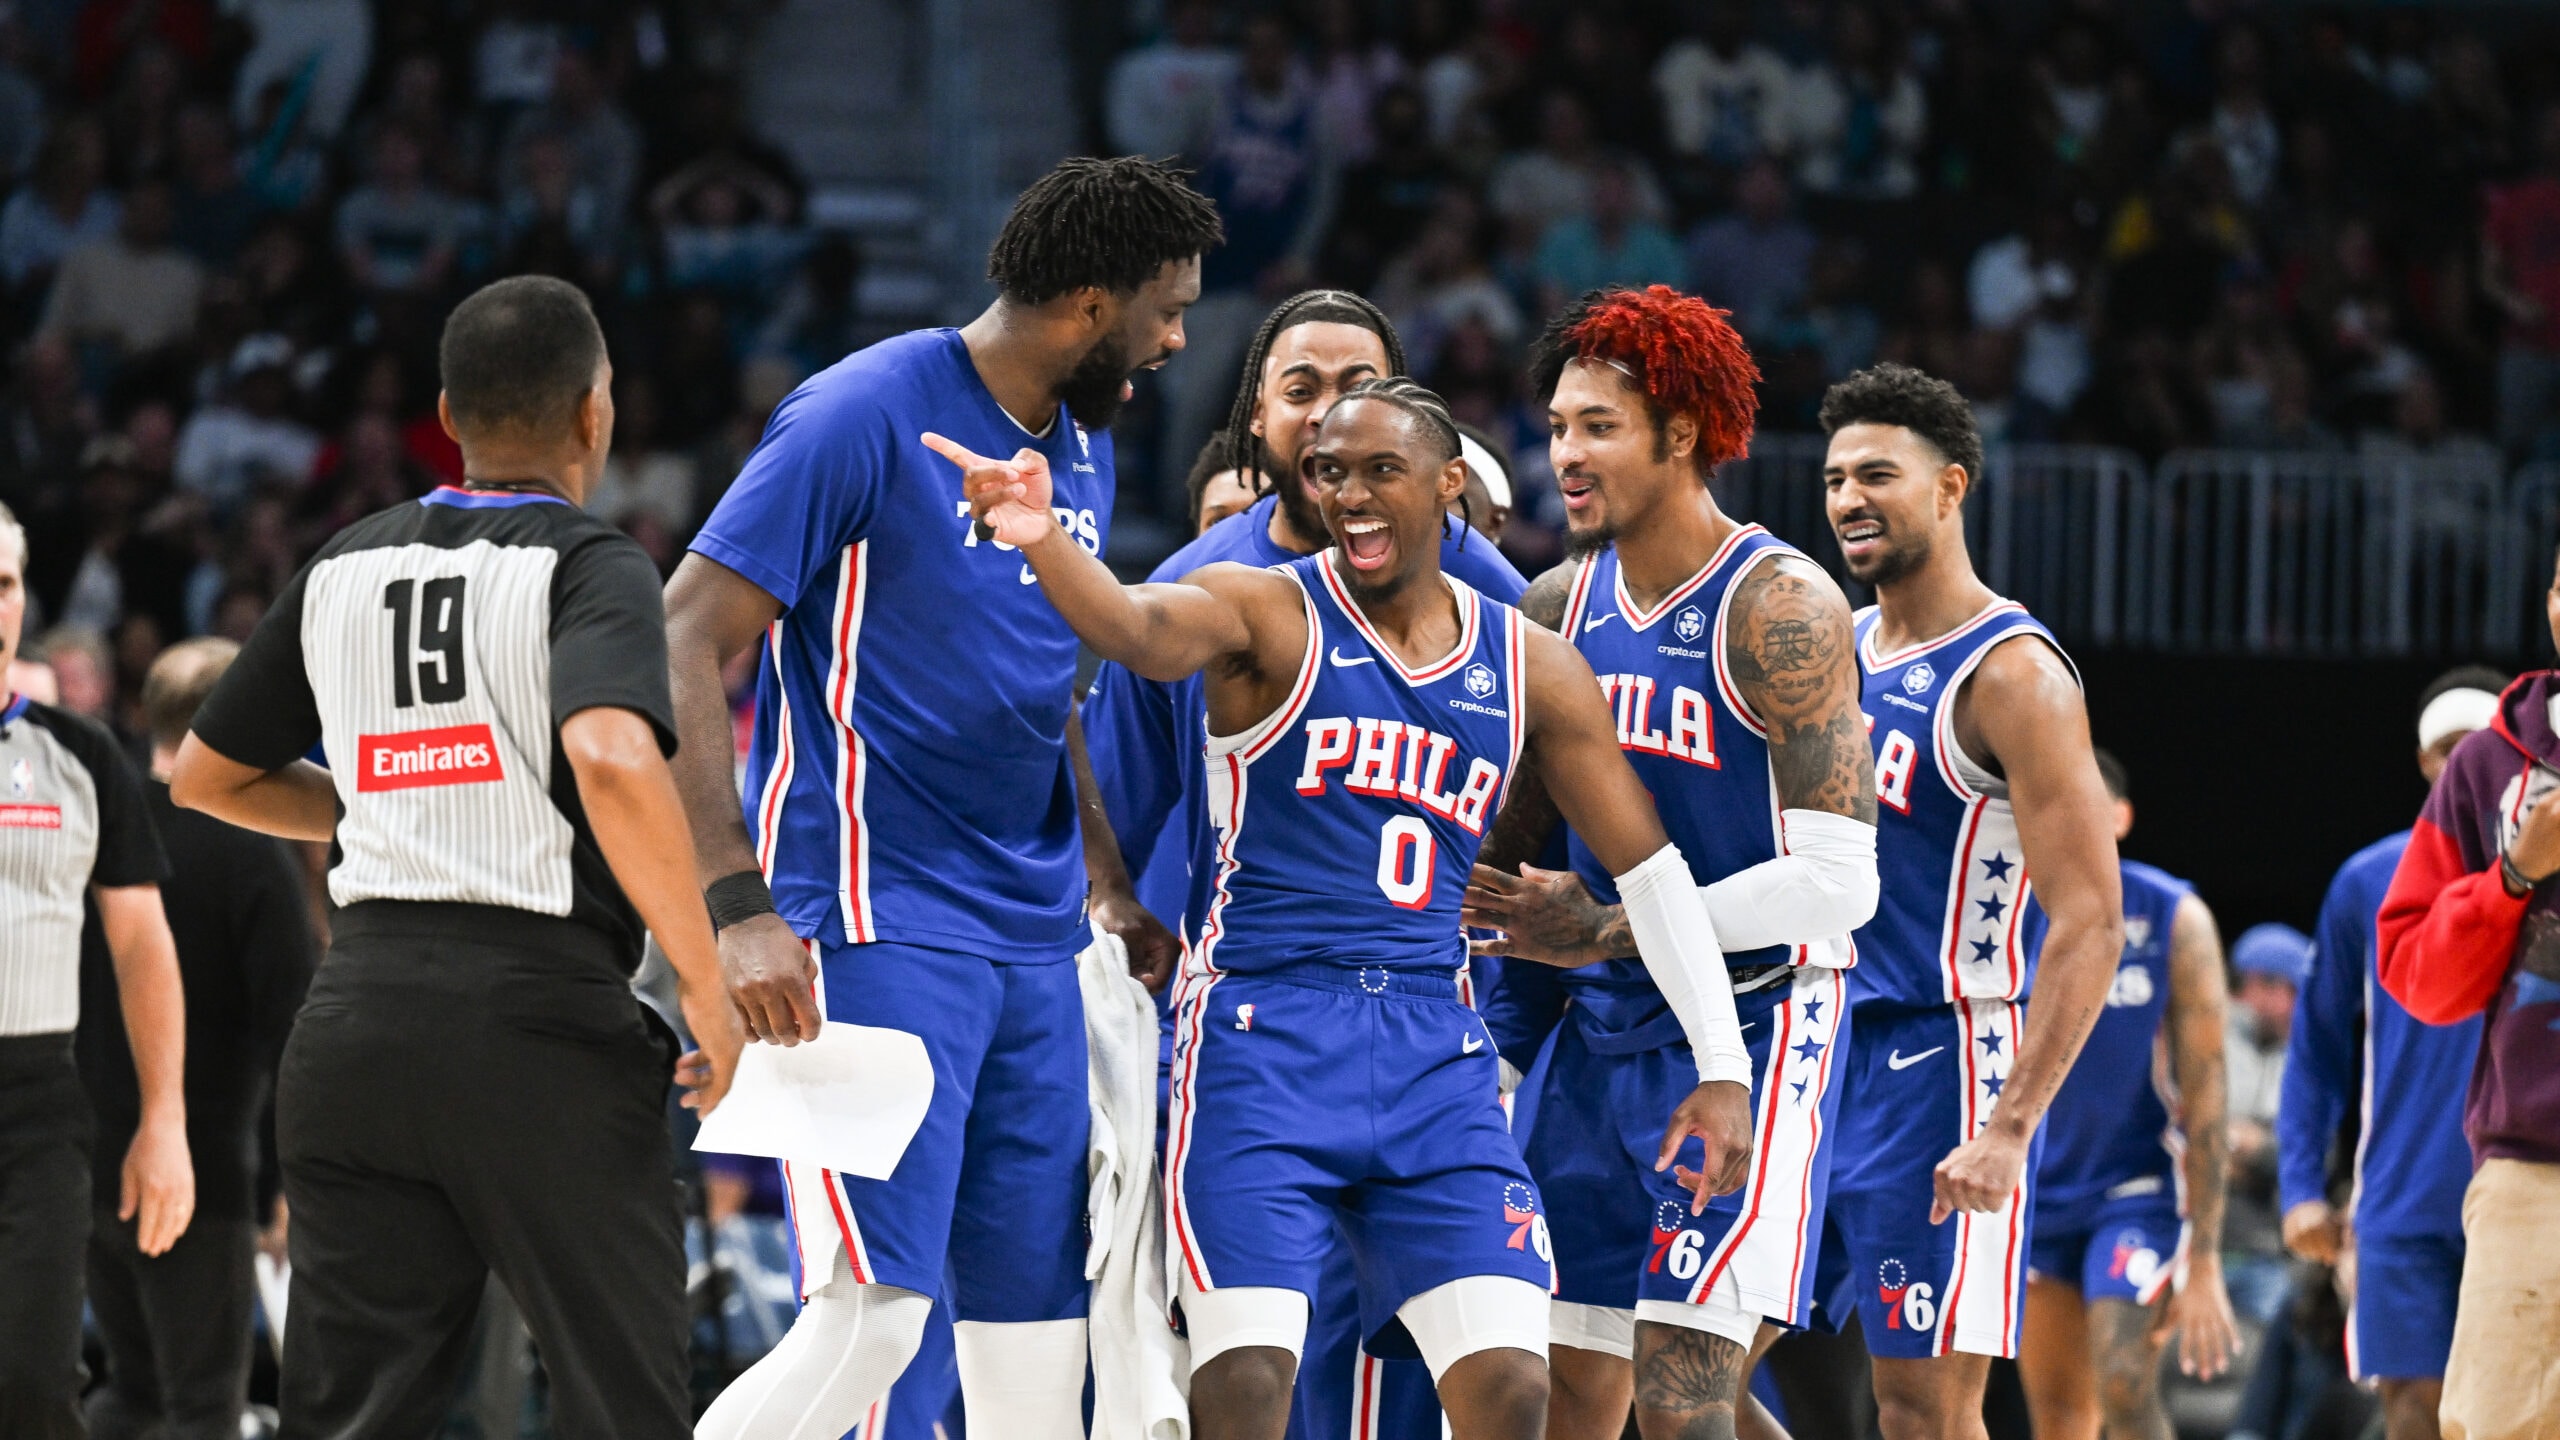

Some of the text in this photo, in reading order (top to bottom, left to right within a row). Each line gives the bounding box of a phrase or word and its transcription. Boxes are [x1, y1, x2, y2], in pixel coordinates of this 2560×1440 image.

[385, 575, 466, 708] 19
[1449, 699, 1507, 718] crypto.com
[374, 743, 491, 777] Emirates
[1296, 717, 1501, 837] PHILA
[1377, 814, 1437, 911] 0
[1504, 1204, 1550, 1262] 76
[1648, 1226, 1705, 1279] 76
[1880, 1283, 1935, 1332] 76
